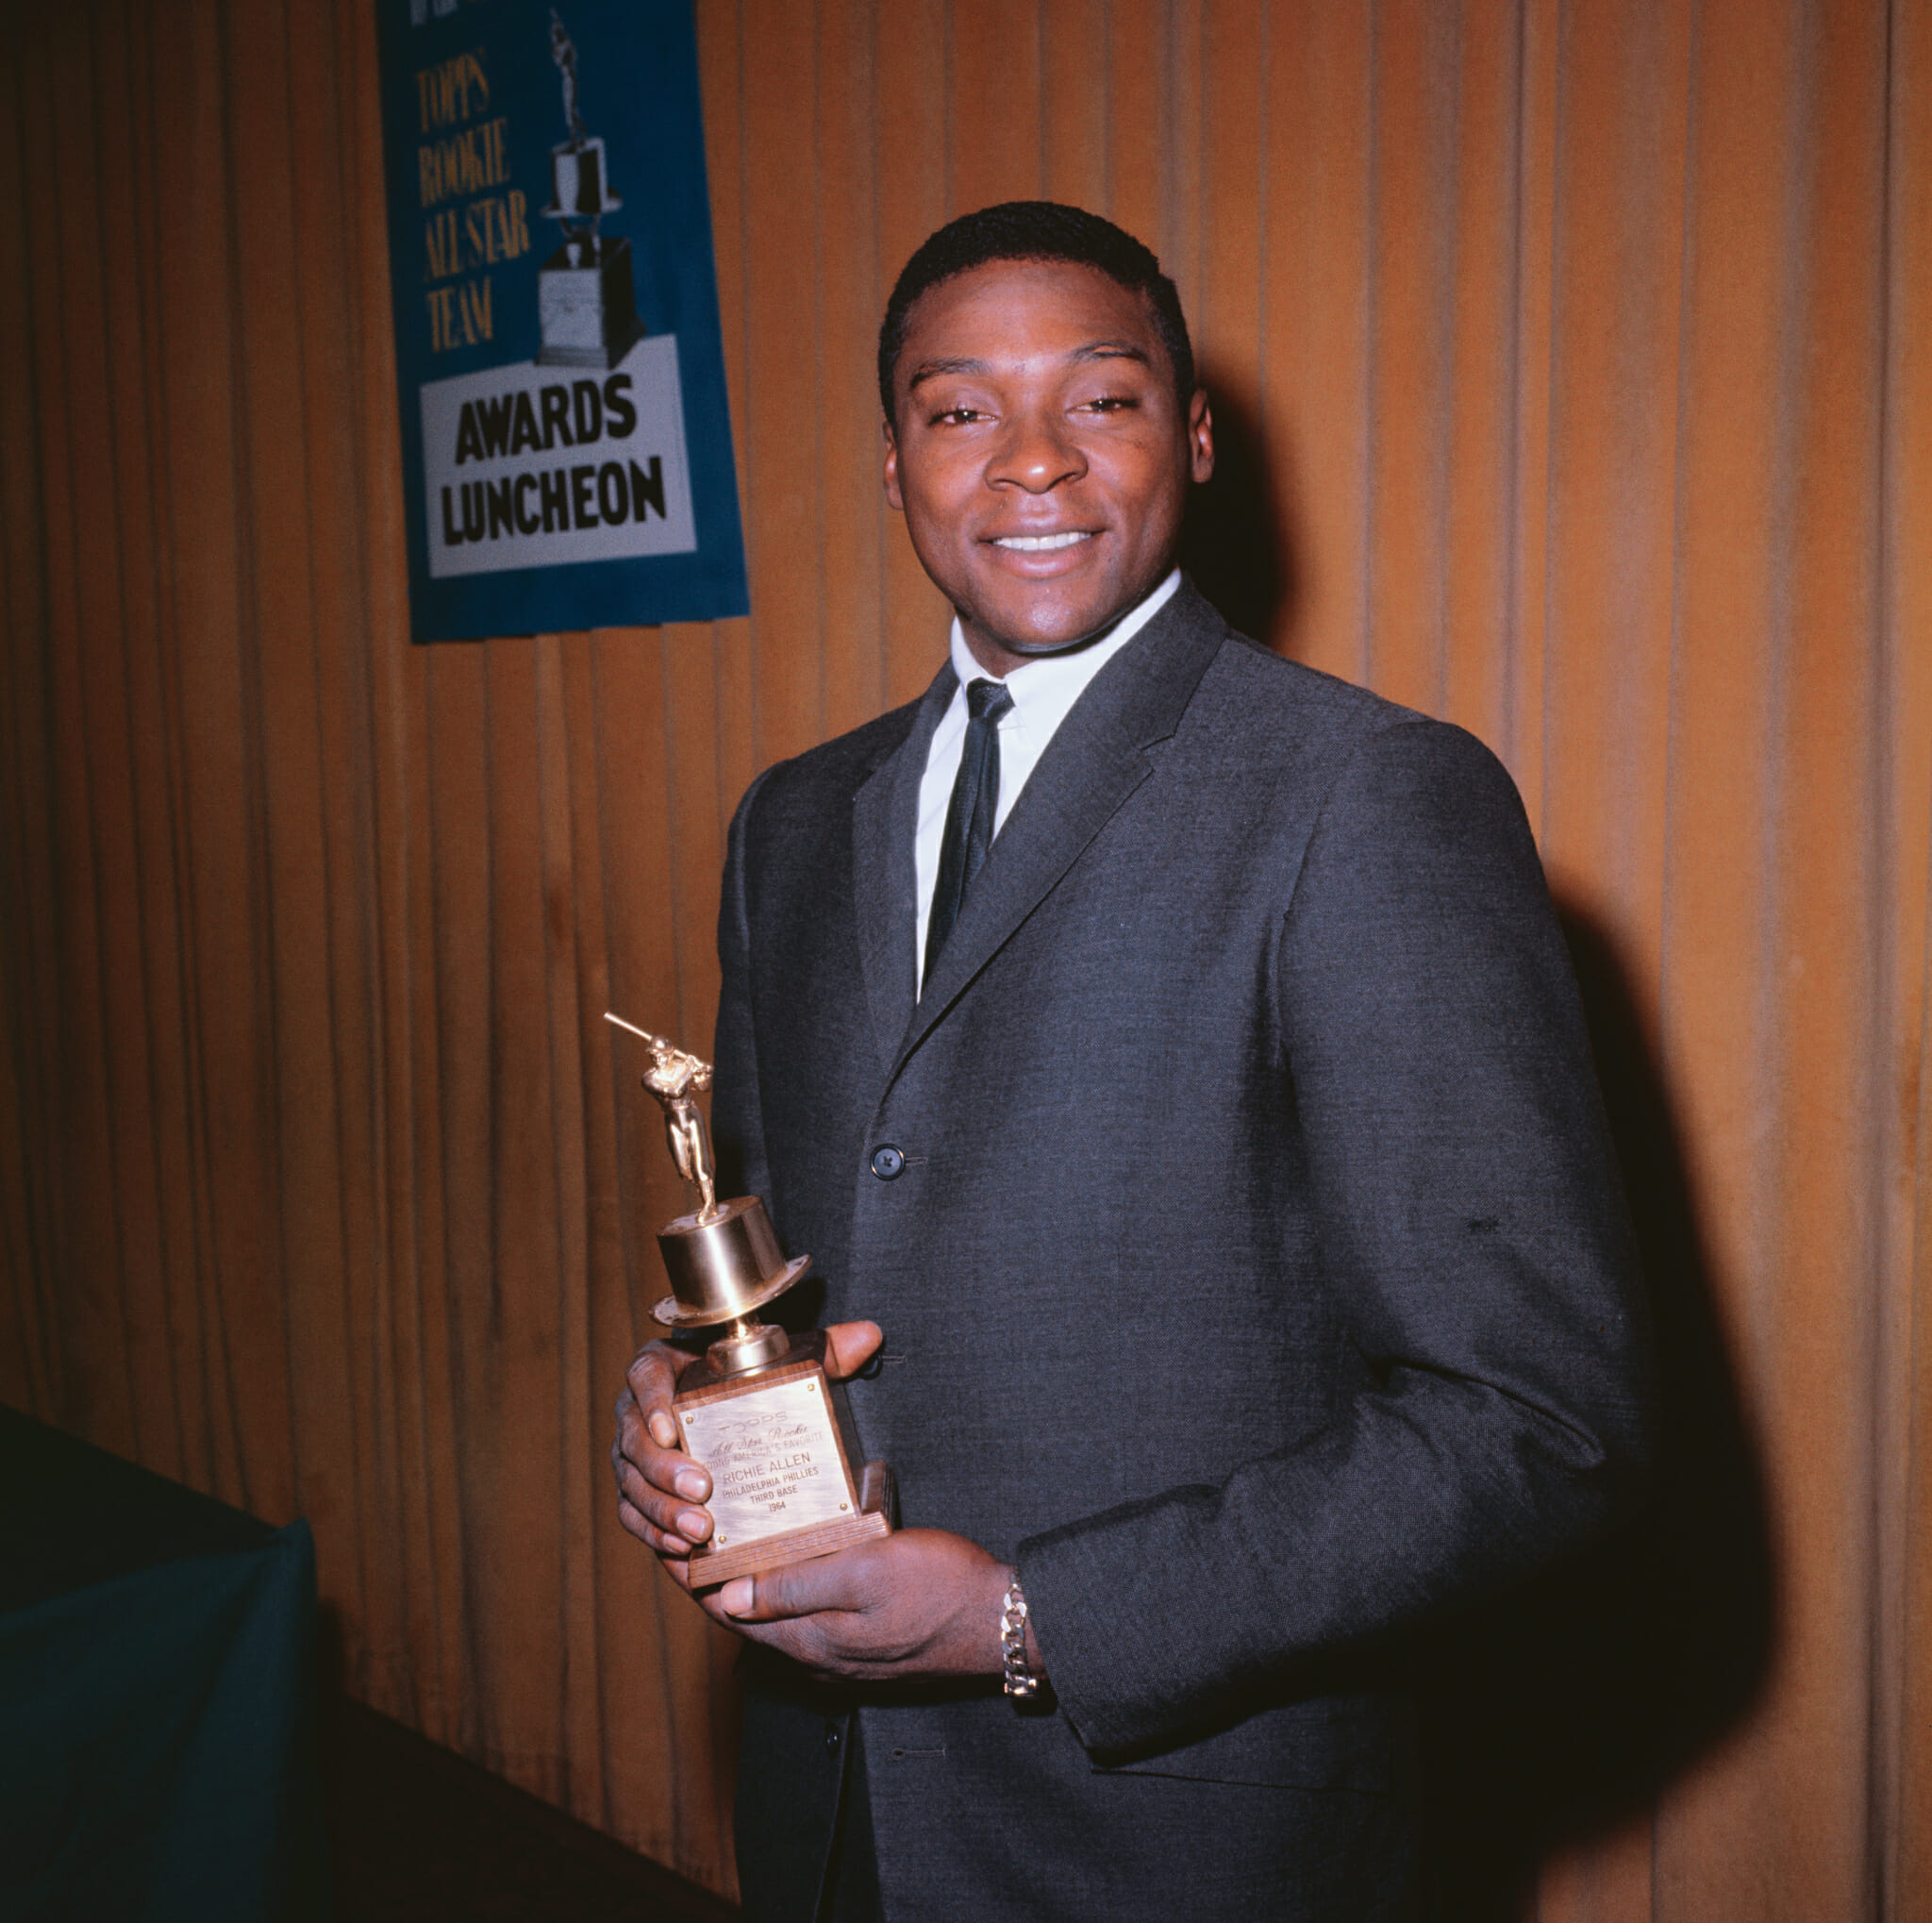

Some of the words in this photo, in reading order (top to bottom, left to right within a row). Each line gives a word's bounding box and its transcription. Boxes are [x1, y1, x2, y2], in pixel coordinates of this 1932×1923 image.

[415, 45, 490, 133] TOPPS
[417, 117, 510, 208] ROOKIE
[426, 275, 493, 352] TEAM
[455, 374, 638, 466] AWARDS
[441, 456, 667, 546] LUNCHEON
[723, 1463, 766, 1484] RICHIE
[770, 1451, 811, 1473] ALLEN
[783, 1430, 824, 1450] FAVORITE
[723, 1477, 780, 1500] PHILADELPHIA
[783, 1465, 820, 1483] PHILLIES
[750, 1491, 774, 1505] THIRD
[776, 1483, 799, 1497] BASE
[769, 1500, 787, 1513] 1964
